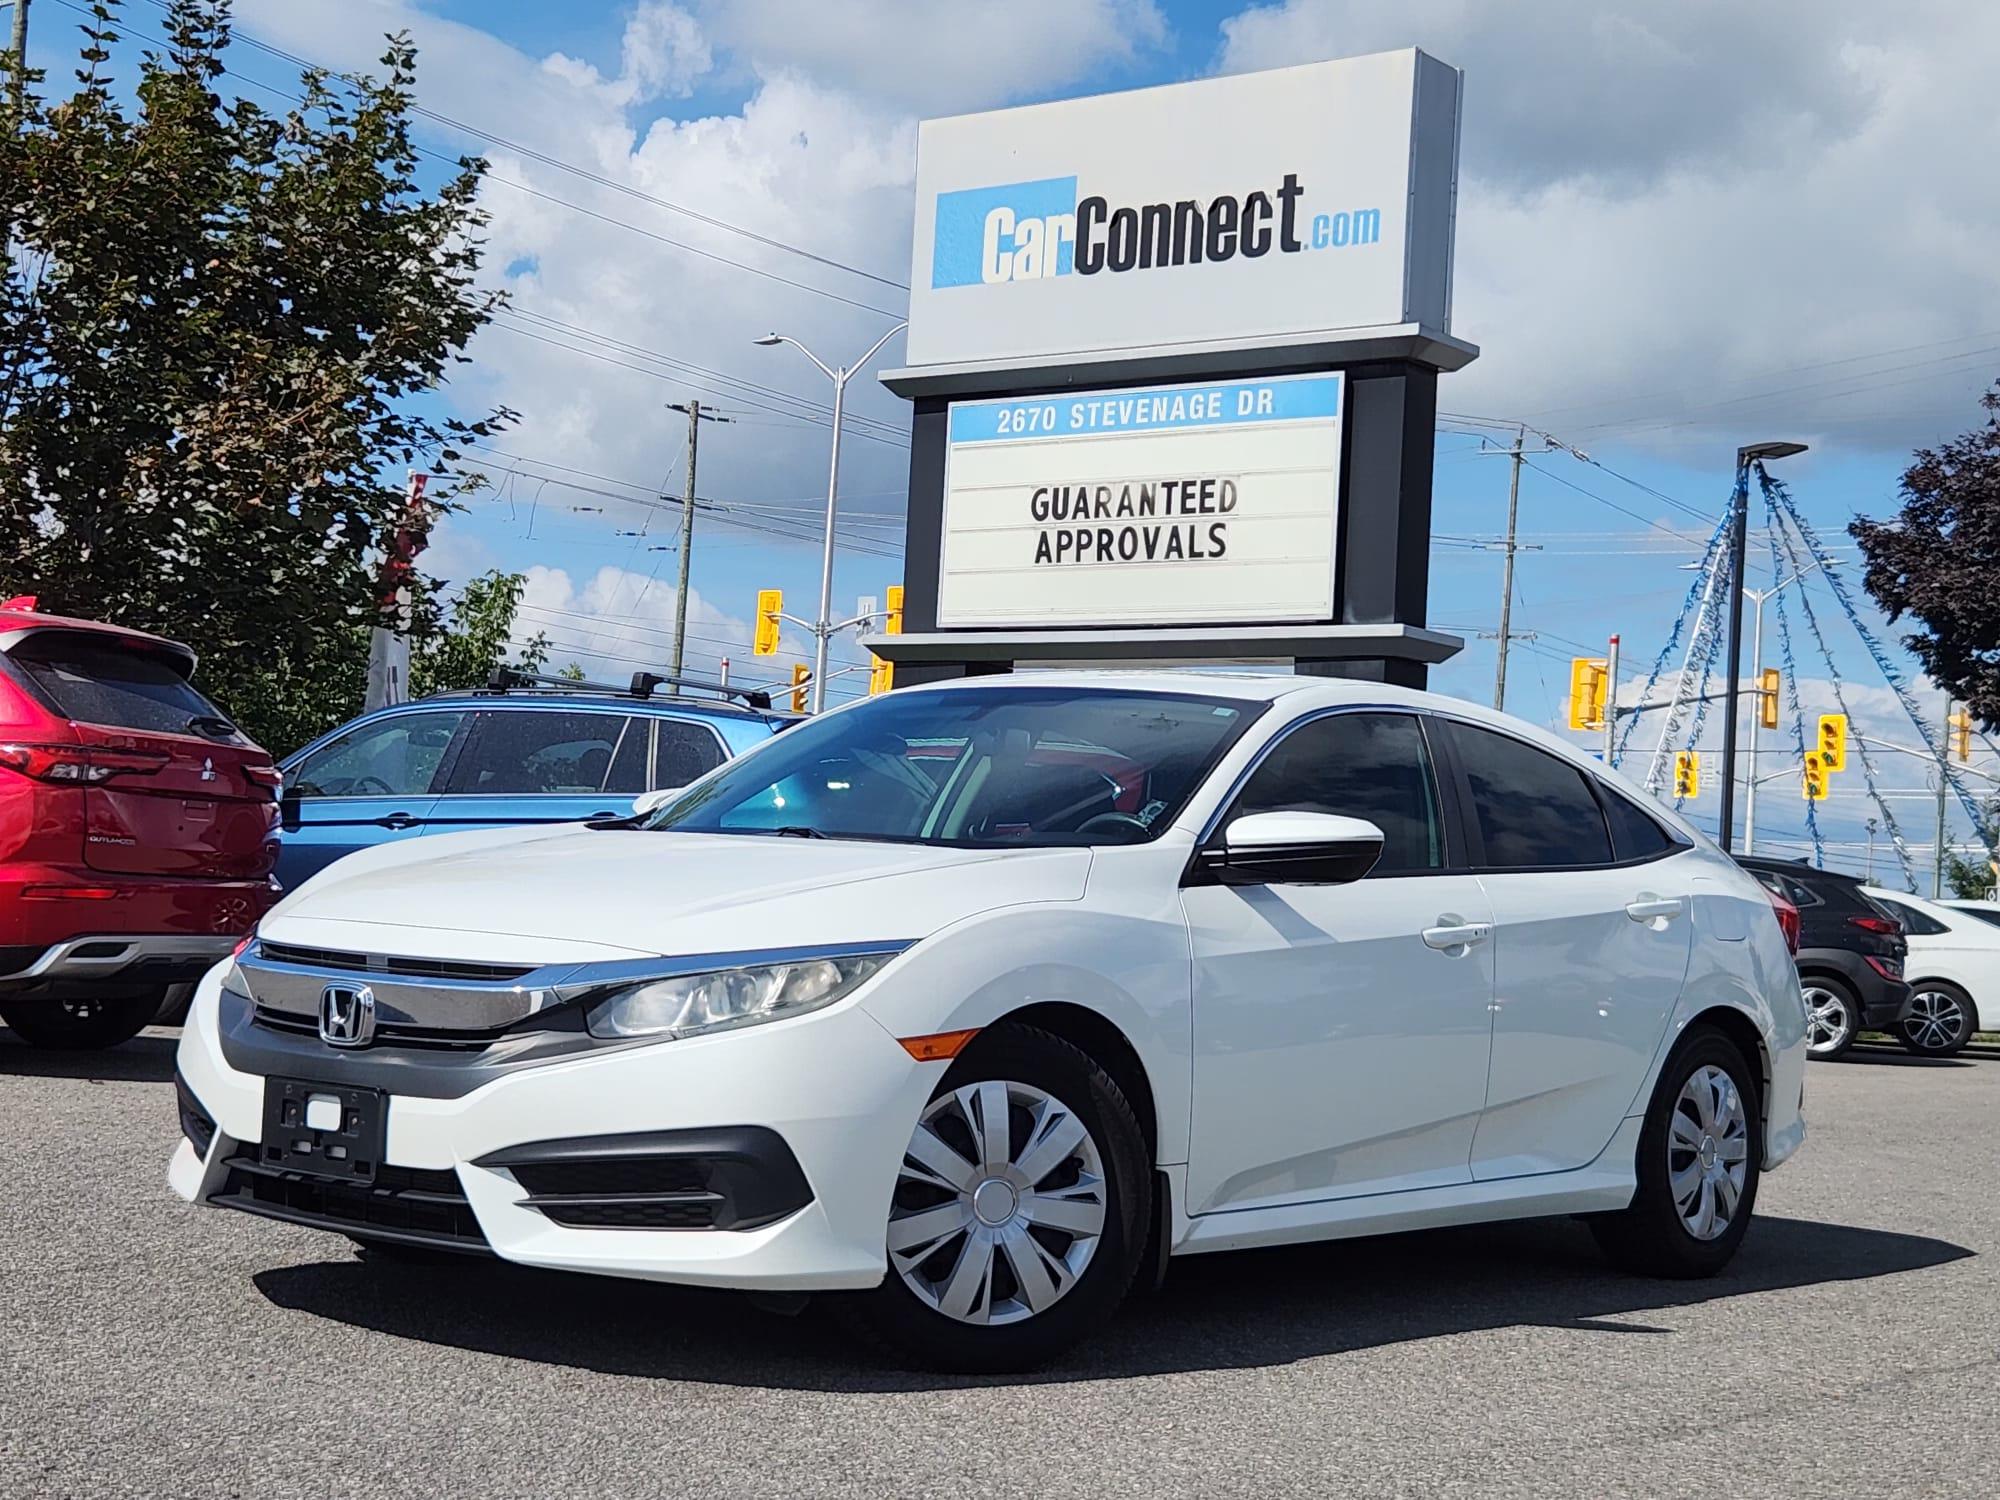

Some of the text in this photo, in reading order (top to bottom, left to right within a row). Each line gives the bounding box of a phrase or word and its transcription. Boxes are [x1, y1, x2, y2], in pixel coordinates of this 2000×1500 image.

[997, 388, 1274, 433] 2670 STEVENAGE DR
[1030, 479, 1238, 522] GUARANTEED
[1034, 522, 1227, 564] APPROVALS
[88, 835, 136, 846] OUTLAD
